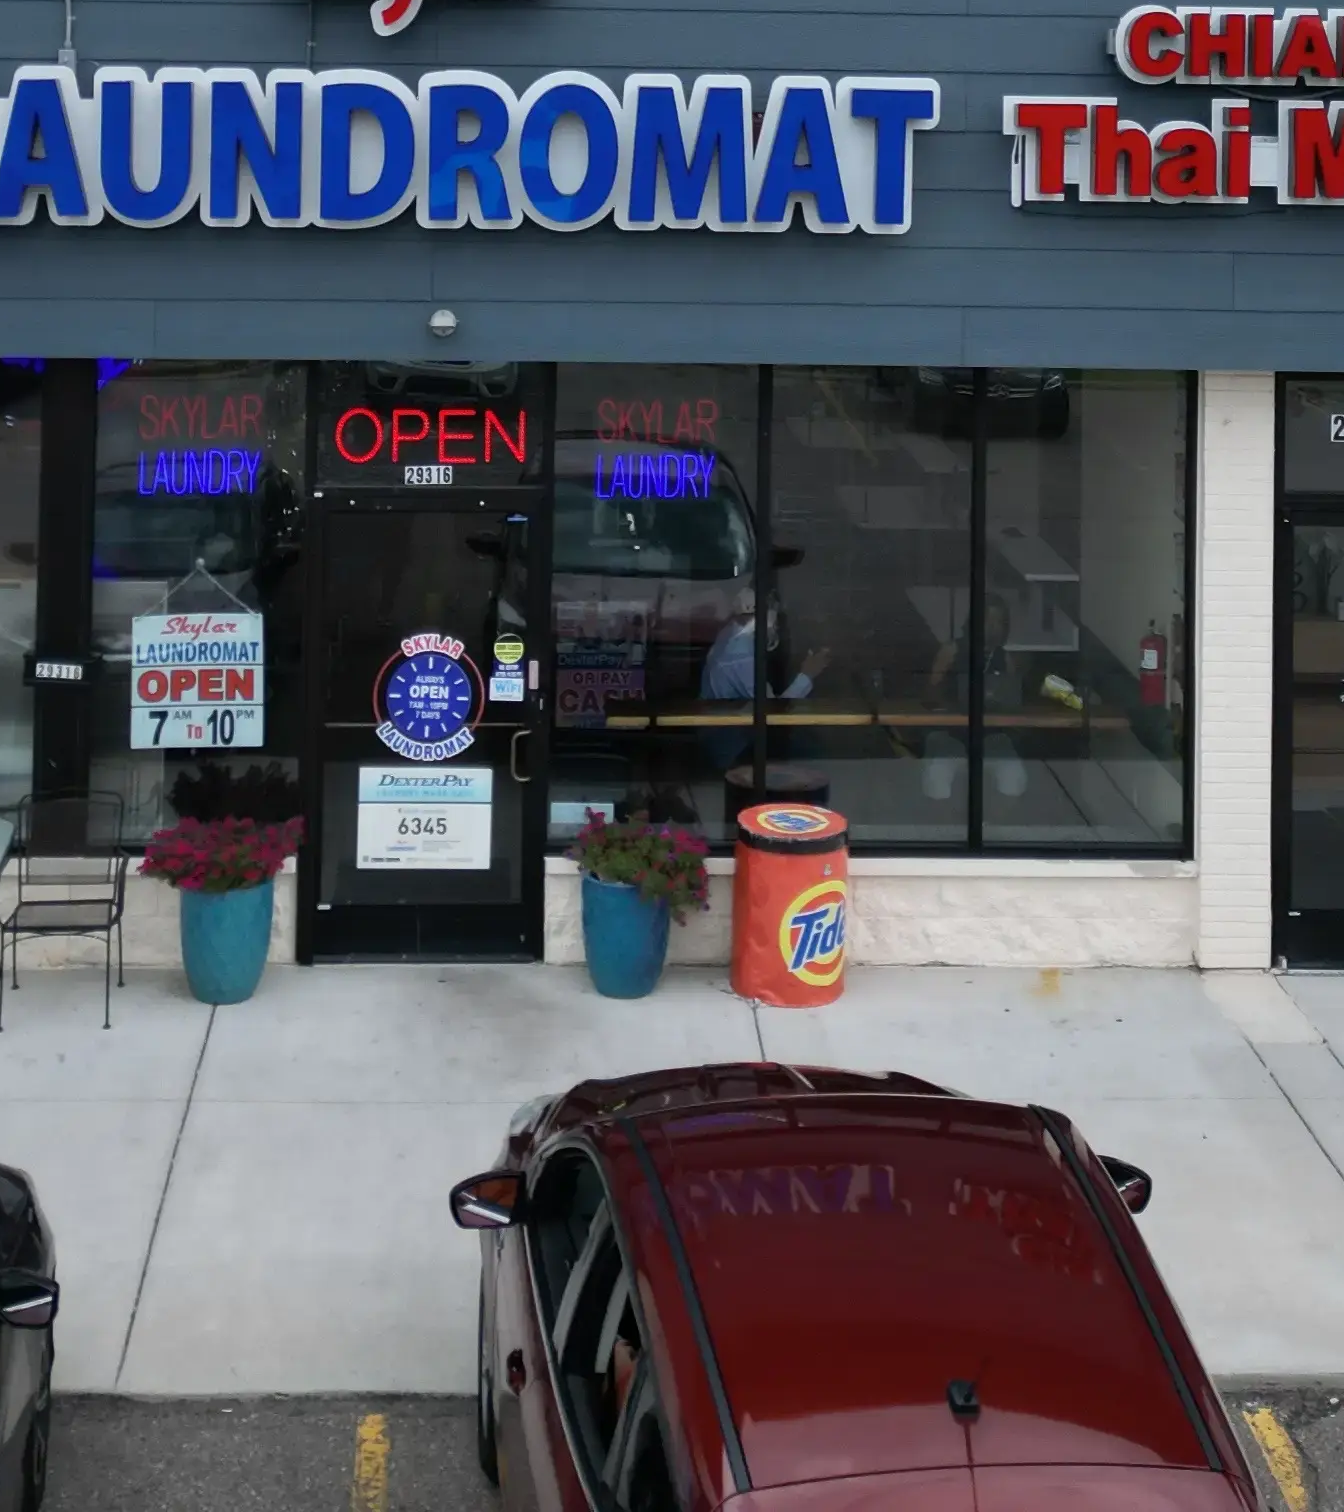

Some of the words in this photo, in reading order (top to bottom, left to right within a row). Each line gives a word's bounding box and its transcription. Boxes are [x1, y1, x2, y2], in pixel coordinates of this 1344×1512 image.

[1015, 101, 1251, 201] Thai
[139, 394, 263, 441] SKYLAR
[334, 407, 527, 464] OPEN
[597, 398, 719, 444] SKYLAR
[137, 450, 262, 496] LAUNDRY
[405, 466, 453, 485] 29316
[595, 453, 716, 499] LAUNDRY
[160, 616, 237, 640] Skylar
[402, 635, 462, 658] SKYLAR
[136, 641, 260, 664] LAUNDROMAT
[136, 668, 255, 703] OPEN
[409, 685, 449, 700] OPEN
[601, 672, 630, 684] PAY
[149, 710, 168, 746] 7
[172, 710, 193, 720] AM
[207, 709, 235, 746] 10
[236, 709, 255, 719] PM
[377, 722, 474, 760] LAUNDROMAT
[397, 817, 447, 835] 6345
[789, 900, 845, 971] Tid
